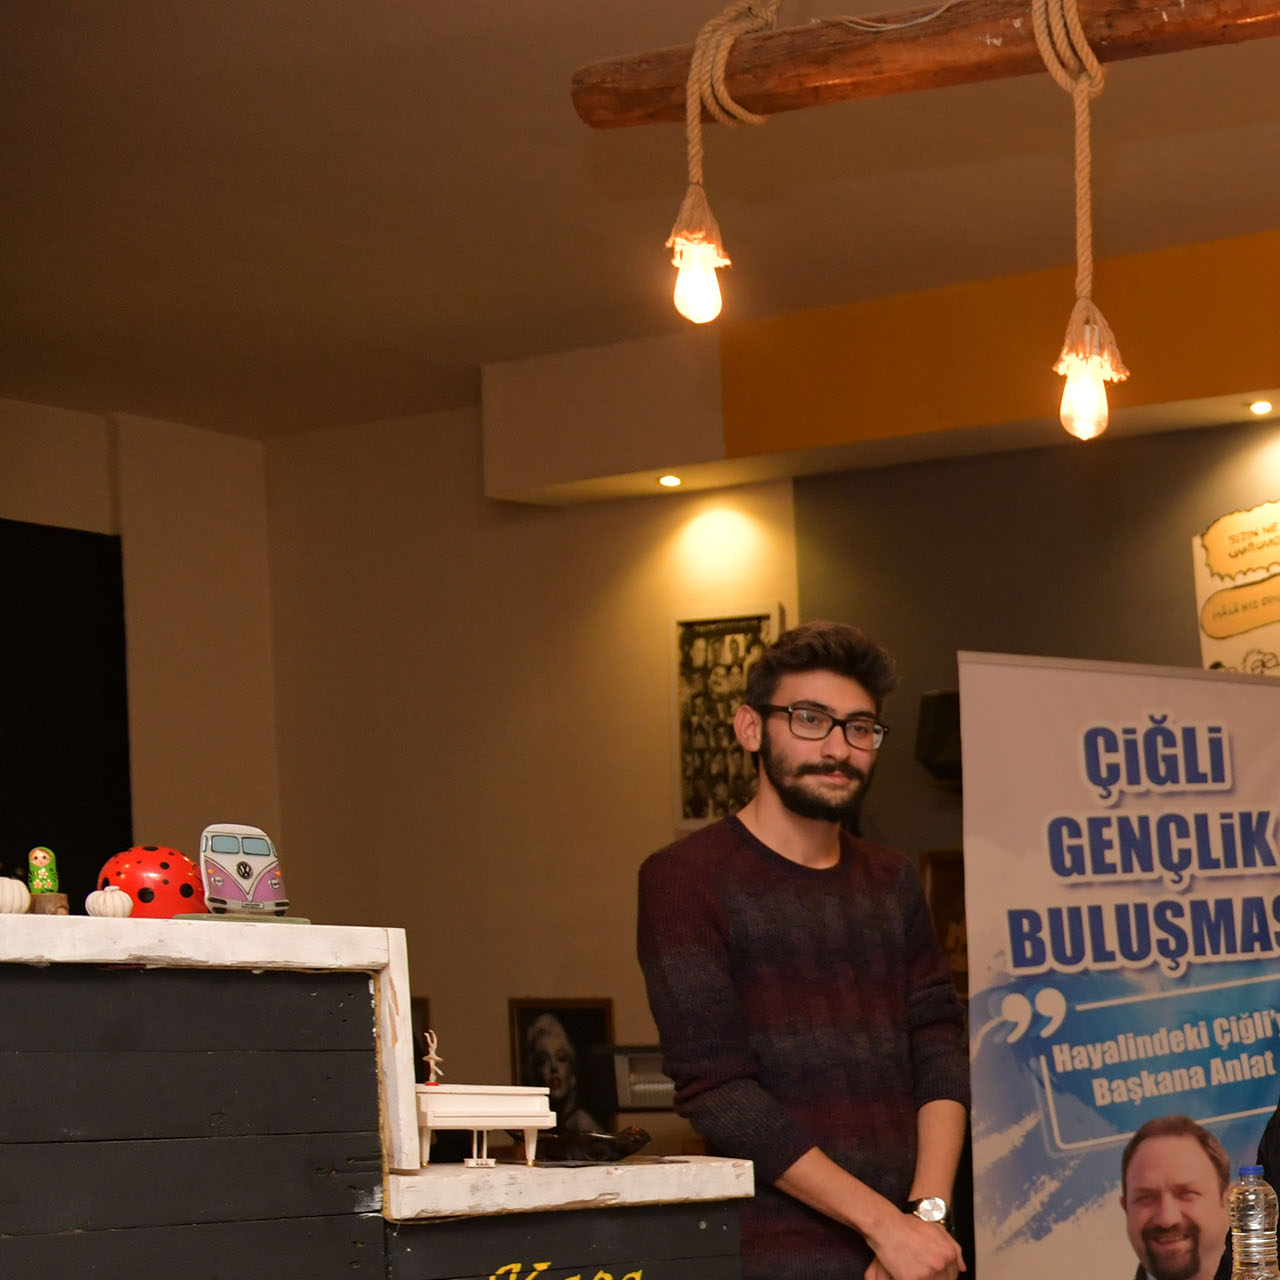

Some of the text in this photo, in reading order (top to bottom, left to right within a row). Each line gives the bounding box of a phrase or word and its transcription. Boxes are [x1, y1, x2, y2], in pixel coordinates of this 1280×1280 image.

[1047, 810, 1277, 884] GENÇLİK
[1051, 1020, 1211, 1074] Hayalindeki
[1091, 1049, 1277, 1107] Başkana Anlat
